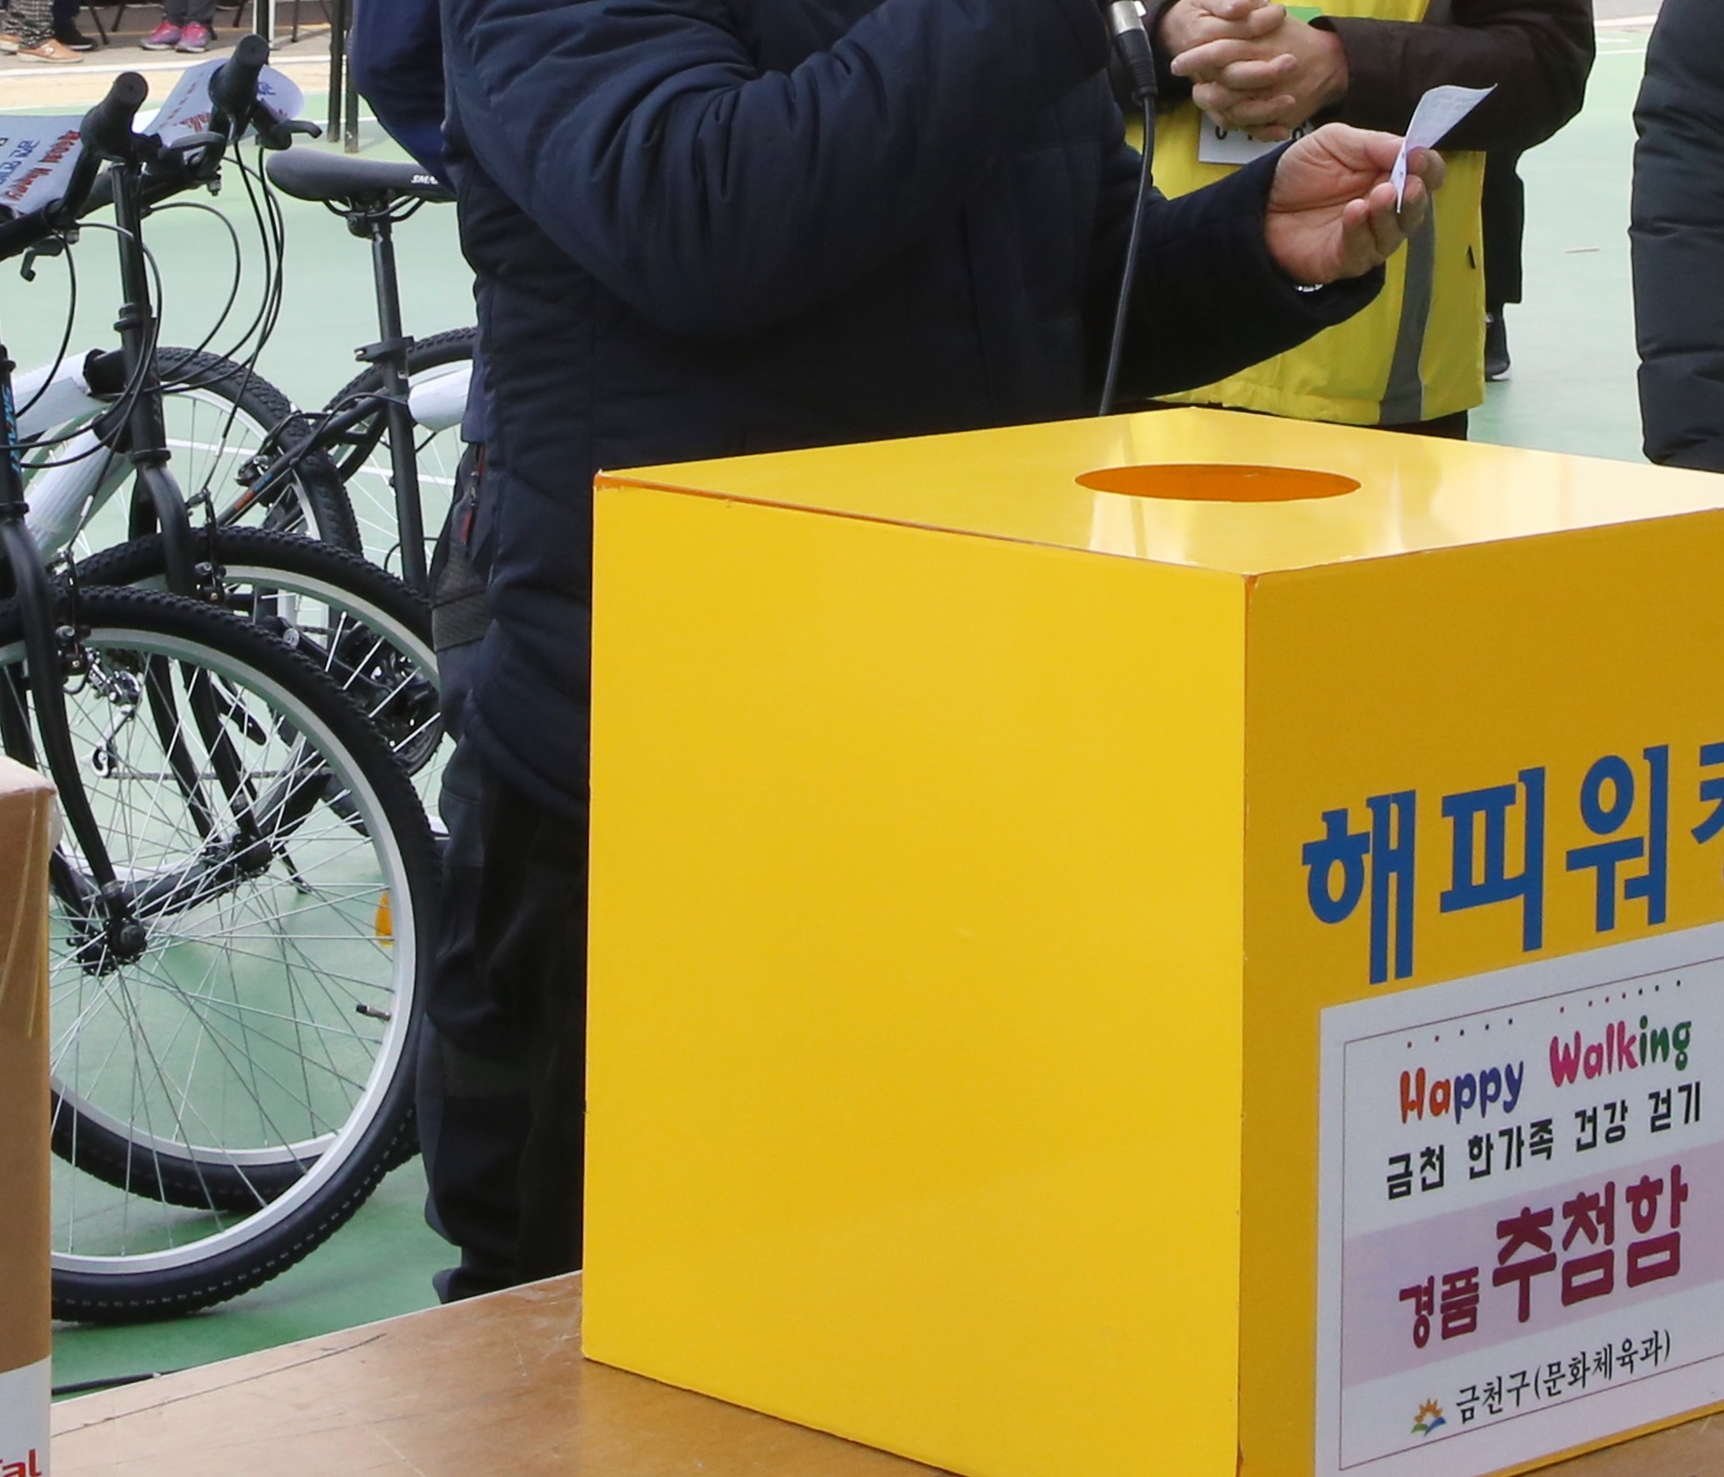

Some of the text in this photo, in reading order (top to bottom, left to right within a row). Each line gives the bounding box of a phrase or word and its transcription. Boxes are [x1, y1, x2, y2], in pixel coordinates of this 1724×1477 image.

[1400, 1015, 1692, 1124] Happy Walking
[1386, 1080, 1701, 1200] 금천 한가족 건강 걷기
[1455, 1328, 1672, 1424] 금천구(문화체육과)
